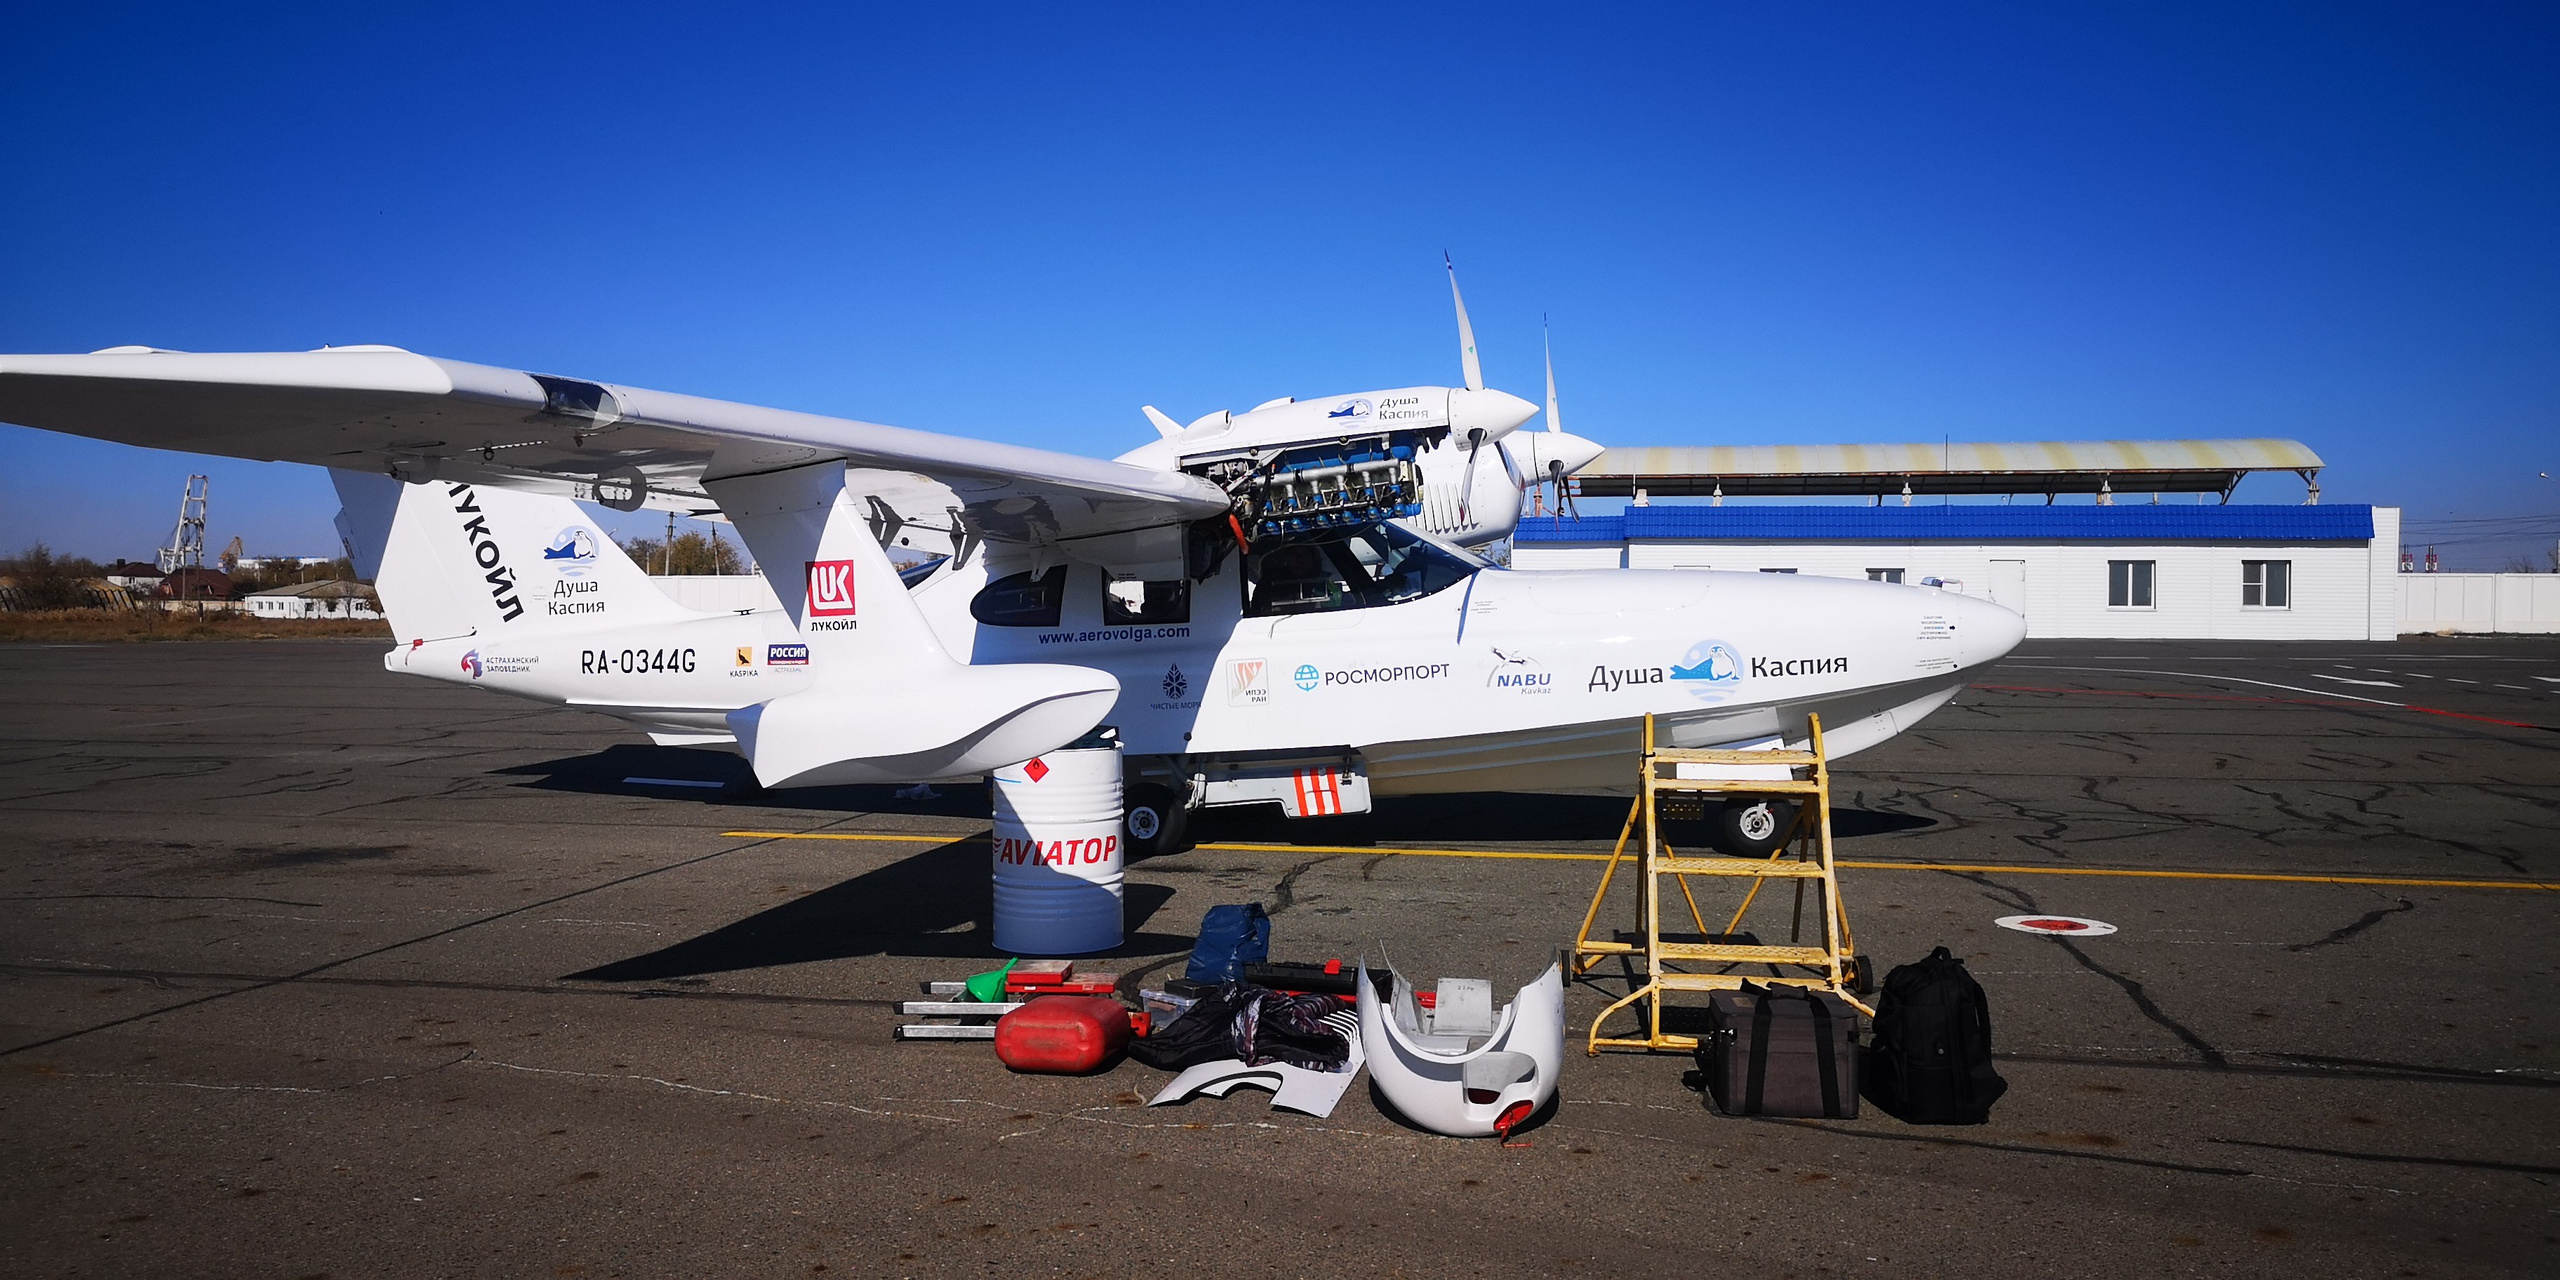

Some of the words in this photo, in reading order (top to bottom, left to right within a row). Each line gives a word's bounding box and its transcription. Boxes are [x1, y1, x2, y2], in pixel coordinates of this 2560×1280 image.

[1380, 397, 1419, 409] Душа
[1379, 409, 1429, 420] Каспия
[553, 579, 599, 598] Душа
[548, 601, 605, 616] Каспия
[811, 618, 857, 631] ЛУКОЙЛ
[1038, 626, 1191, 644] www.aerovolga.com
[770, 647, 807, 658] РОССИЯ
[485, 655, 540, 664] АСТРАХАНСКИЙ
[581, 648, 696, 675] RA-0344G
[486, 665, 531, 673] ЗАПОВЕДНИК
[729, 669, 759, 678] KASPIKA
[1325, 663, 1450, 686] РОСМОРПОРТ
[1588, 665, 1664, 692] Душа
[1751, 656, 1849, 678] Каспия
[1497, 673, 1552, 688] NABU
[1521, 687, 1552, 695] Kavkaz
[1150, 702, 1180, 710] ЧИСТЫЕ
[1180, 701, 1201, 709] МОРЯ
[1000, 835, 1117, 866] AVIATOP
